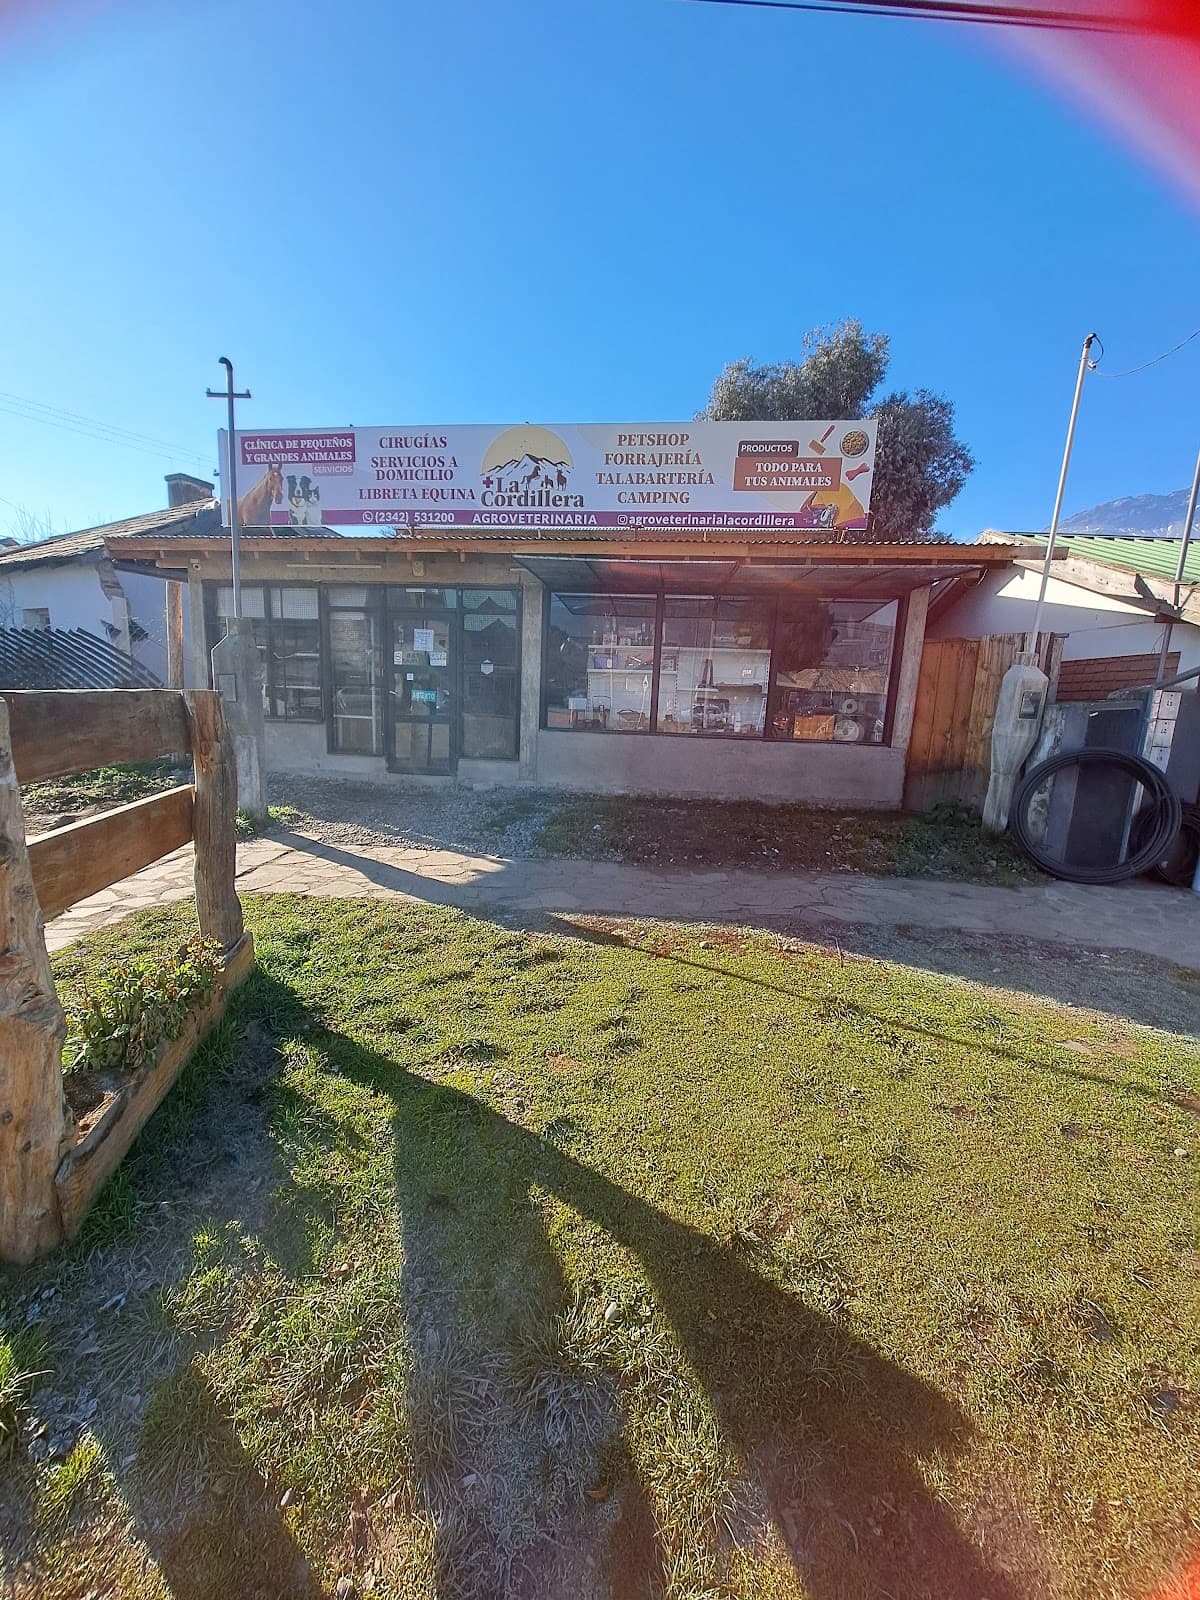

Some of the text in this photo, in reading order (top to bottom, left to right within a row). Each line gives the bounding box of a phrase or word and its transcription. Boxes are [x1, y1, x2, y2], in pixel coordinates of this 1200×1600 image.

[244, 437, 353, 450] CLÍNICA DE PEQUEÑOS
[379, 433, 447, 448] CIRUGÍAS
[617, 433, 690, 446] PETSHOP
[741, 444, 793, 453] PRODUCTOS
[245, 451, 353, 463] Y GRANDES ANIMALES
[370, 456, 459, 468] SERVICIOS A
[604, 449, 702, 467] FORRAJERÍA
[313, 465, 353, 474] SERVICIOS
[755, 462, 822, 473] TODO PARA
[376, 469, 454, 481] DOMICILIO
[595, 469, 715, 485] TALABARTERÍA
[744, 476, 832, 487] TUS ANIMALES
[496, 477, 520, 493] La
[359, 488, 476, 502] LIBRETA EQUINA
[481, 489, 584, 507] Cordillera
[617, 491, 690, 504] CAMPING
[375, 511, 455, 523] (2342) 531200
[472, 513, 597, 525] AGROVETERINARIA
[628, 514, 795, 527] agroveterinarialacordillera
